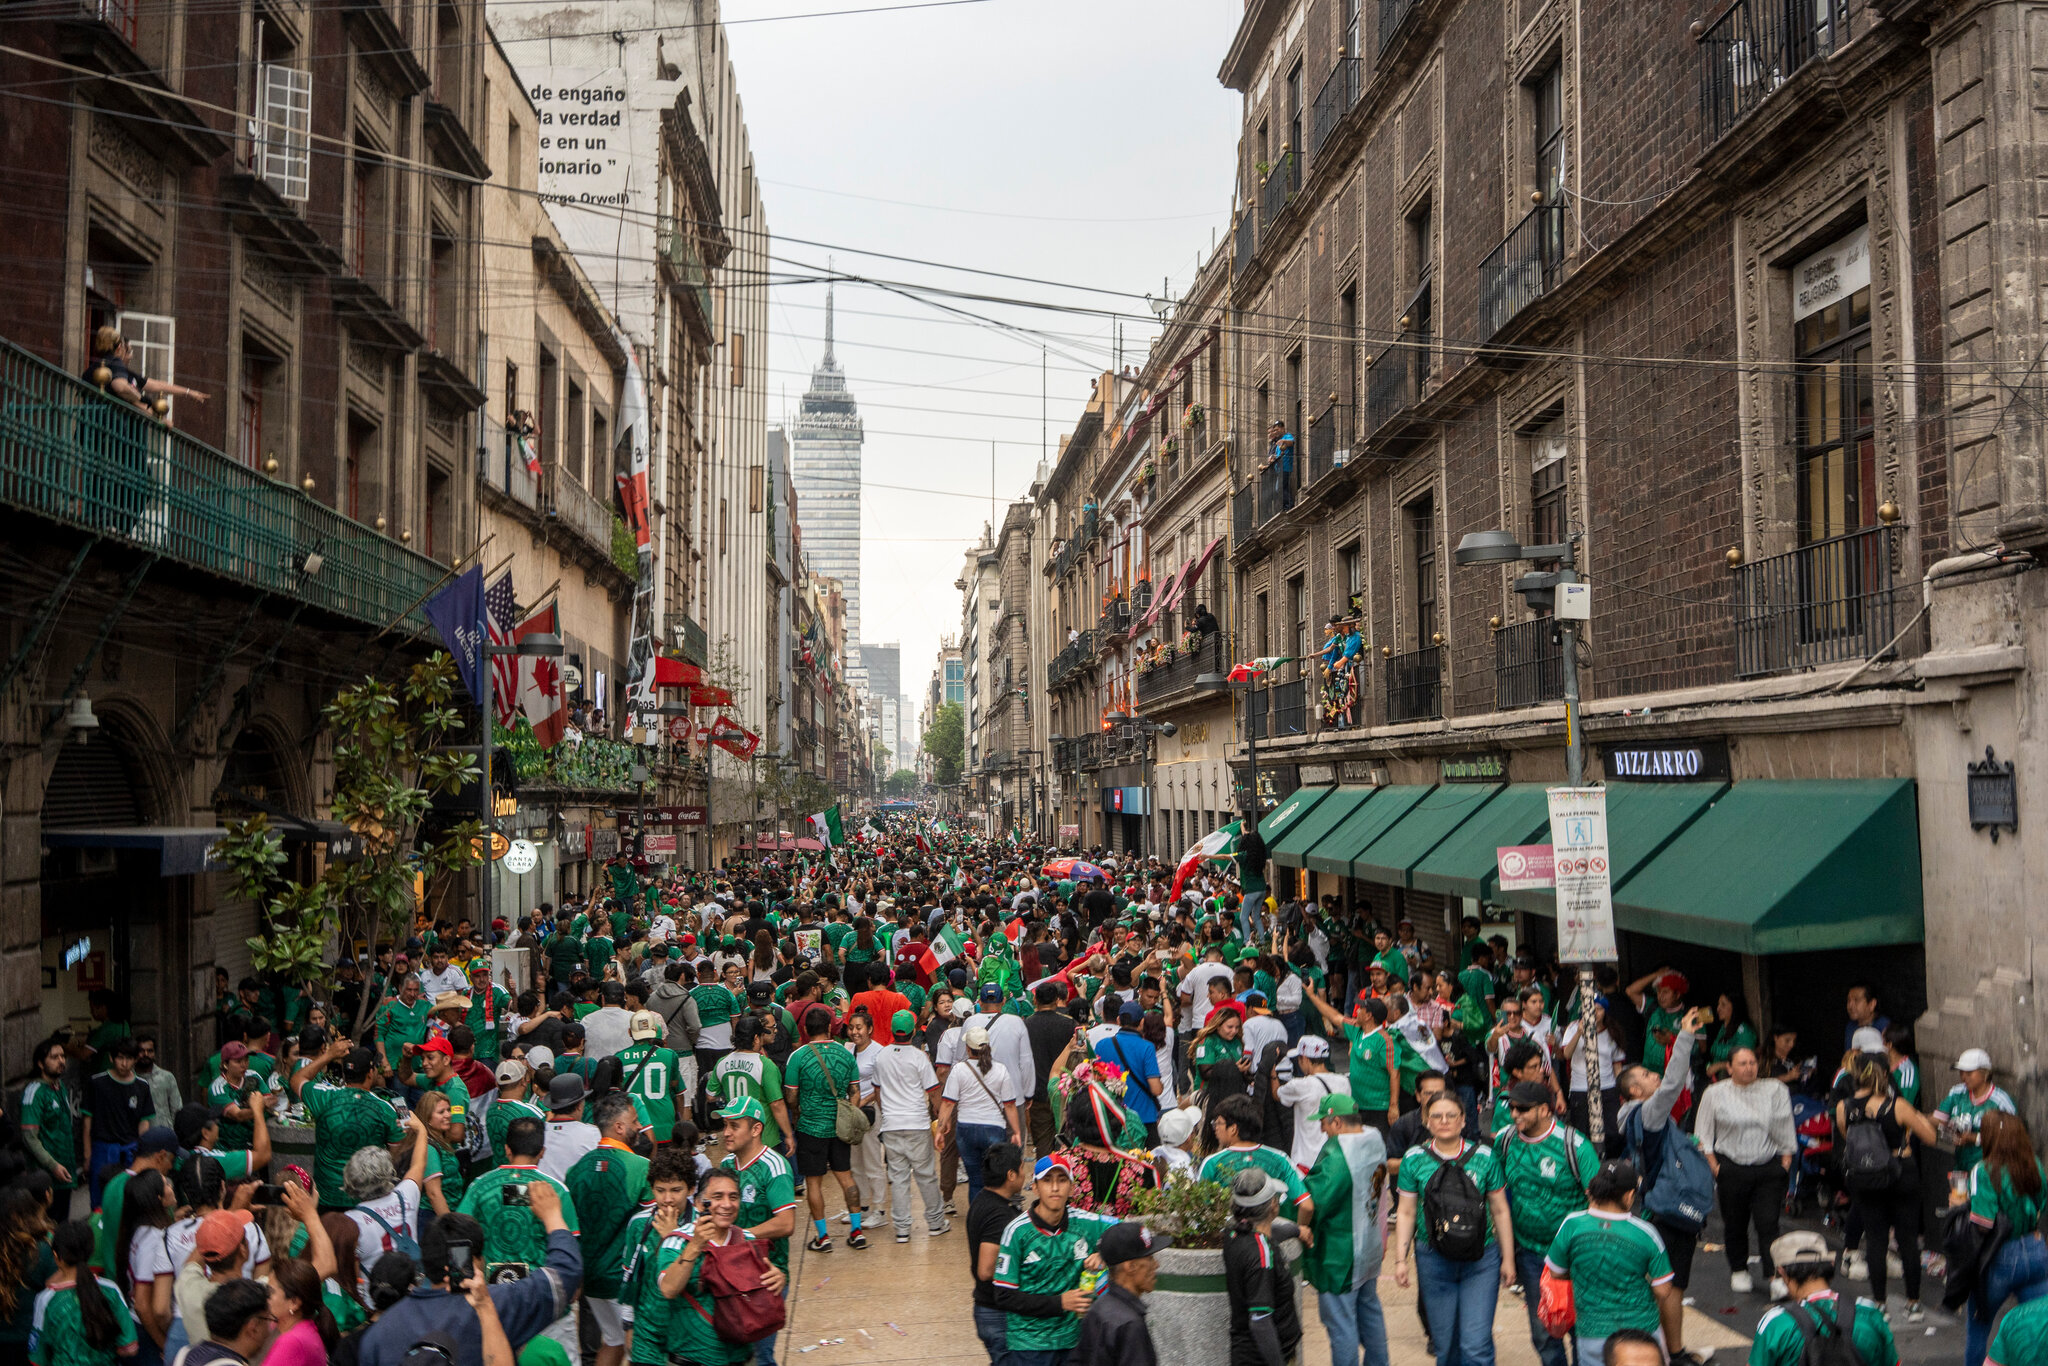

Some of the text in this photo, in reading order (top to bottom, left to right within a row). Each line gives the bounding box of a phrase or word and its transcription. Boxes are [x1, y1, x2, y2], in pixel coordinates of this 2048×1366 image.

[531, 84, 626, 105] de engaño
[559, 110, 621, 126] verdad
[557, 137, 579, 150] en
[585, 138, 606, 150] un
[1614, 749, 1699, 776] BIZZARRO
[725, 1059, 754, 1073] C.BLANCO
[728, 1075, 750, 1100] 10
